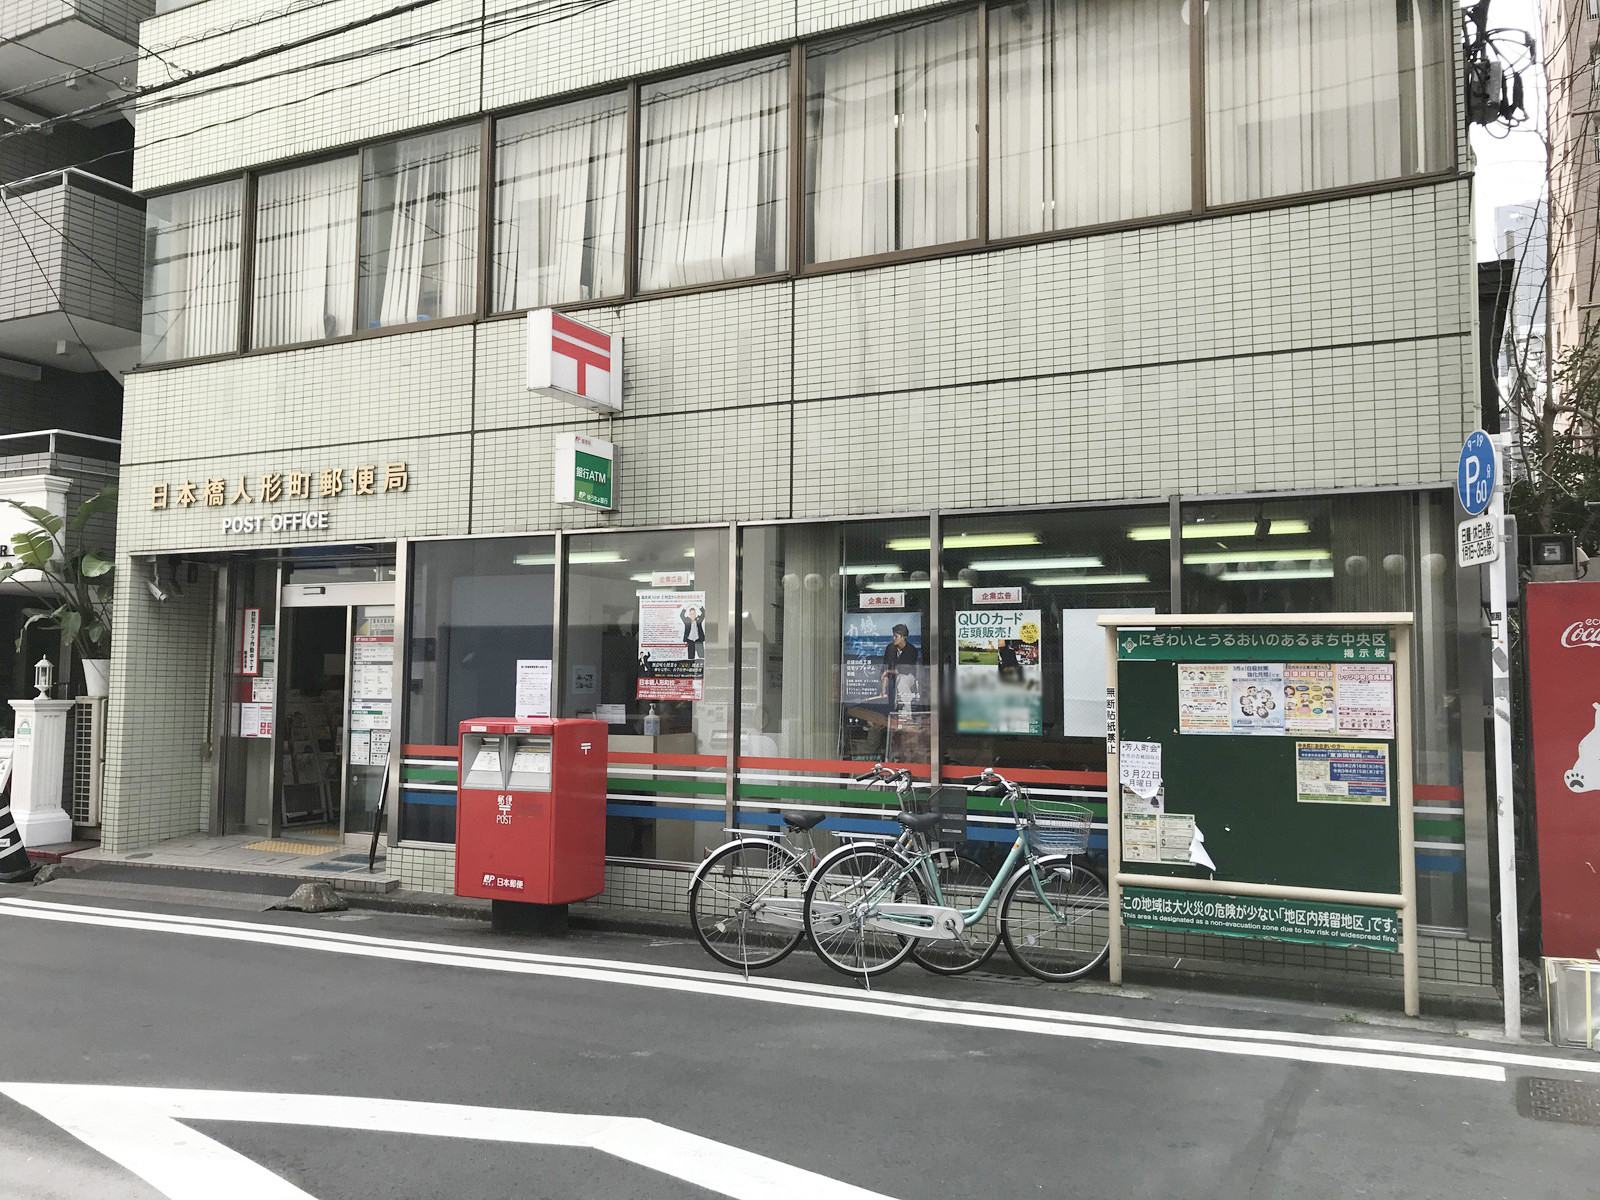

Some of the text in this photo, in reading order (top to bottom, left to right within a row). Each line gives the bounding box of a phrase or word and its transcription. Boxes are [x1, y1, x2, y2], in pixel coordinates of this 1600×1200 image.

[1467, 434, 1484, 452] 9-19
[576, 466, 606, 484] 銀行ATM
[1465, 455, 1480, 508] P
[149, 461, 409, 510] 日本橋人形町郵便局
[1475, 479, 1487, 504] 60
[586, 494, 608, 504] ゆうちょ銀行
[221, 510, 329, 534] POST OFFICE
[868, 597, 896, 605] 企業広告
[981, 592, 1012, 600] 企業広告
[958, 612, 1024, 626] QUOカード
[1585, 618, 1600, 626] ec
[1139, 633, 1386, 647] にぎわいとうるおいのあるまち中央区
[1343, 648, 1385, 658] 掲示板
[1106, 687, 1116, 755] 無断貼紙禁止
[1123, 769, 1160, 779] 3月22日
[1129, 779, 1152, 787] 月曜日
[497, 794, 513, 806] 郵便
[496, 814, 513, 825] POST
[497, 877, 524, 890] 日本郵便
[1123, 896, 1397, 934] この地域は大火災の危険が少ない「地区内残留地区」です。
[1123, 911, 1136, 919] This
[1159, 914, 1194, 924] designated
[1210, 919, 1261, 930] non-evacuation
[1280, 925, 1293, 933] due
[1303, 927, 1316, 935] low
[1331, 929, 1339, 937] of
[1339, 931, 1381, 941] widespread
[1382, 934, 1397, 943] fire.
